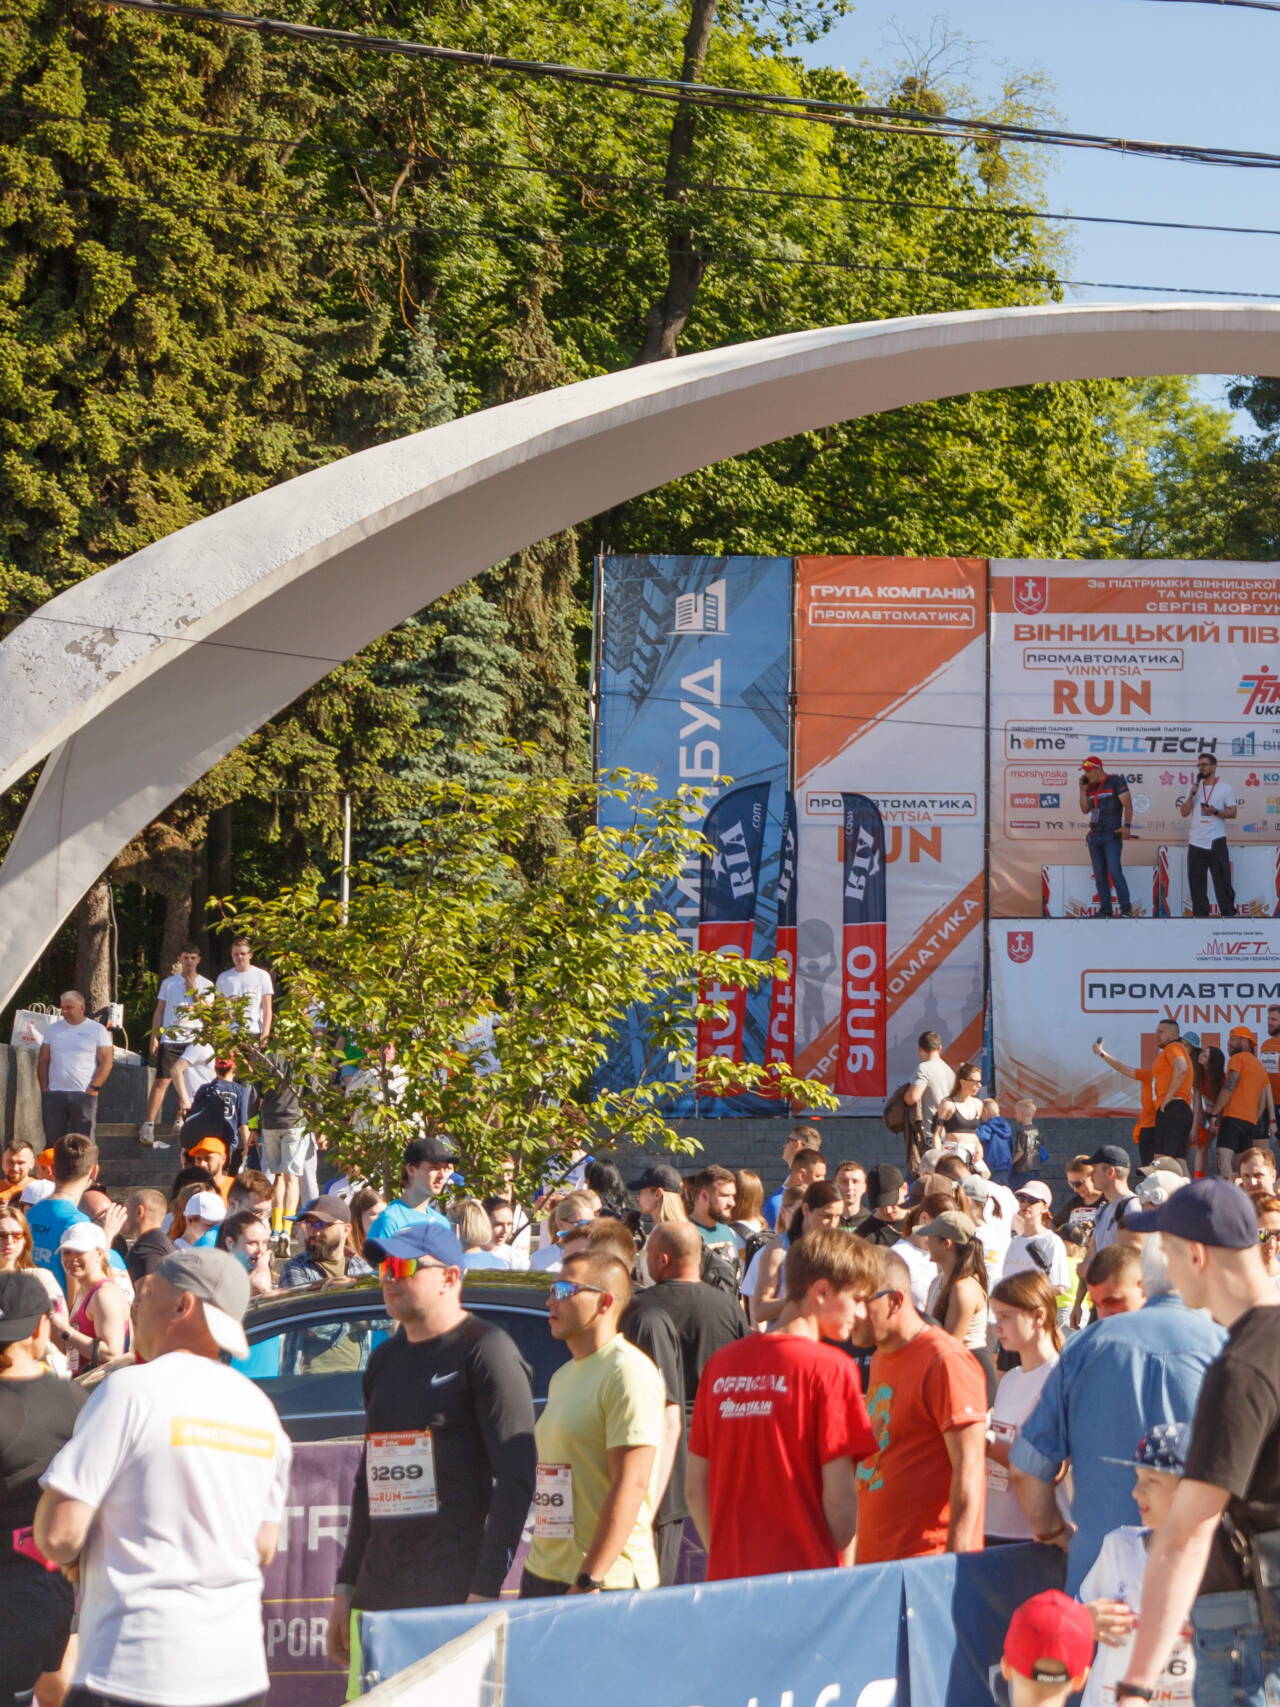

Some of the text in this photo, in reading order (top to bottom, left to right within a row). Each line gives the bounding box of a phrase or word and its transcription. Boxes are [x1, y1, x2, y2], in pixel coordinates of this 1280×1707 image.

[1088, 581, 1104, 589] За
[1109, 580, 1190, 590] ПІДТРИМКИ
[1194, 579, 1275, 591] ВІННИЦЬКОЇ
[810, 585, 975, 600] ГРУПА КОМПАНІЙ
[1157, 590, 1176, 599] ТА
[1180, 590, 1248, 600] МІСЬКОГО
[1146, 602, 1208, 612] СЕРГІЯ
[814, 609, 971, 622] ПРОМАВТОМАТИКА
[1014, 621, 1220, 645] ВІННИЦЬКИЙ
[1027, 654, 1180, 664] ПРОМАВТОМАТИКА
[1065, 665, 1142, 676] VINNYTSIA
[1053, 680, 1152, 716] RUN
[1088, 735, 1217, 753] BILLTECH
[1226, 942, 1268, 955] VFT
[713, 1375, 788, 1393] OFFICIAL
[371, 1465, 423, 1481] 3269
